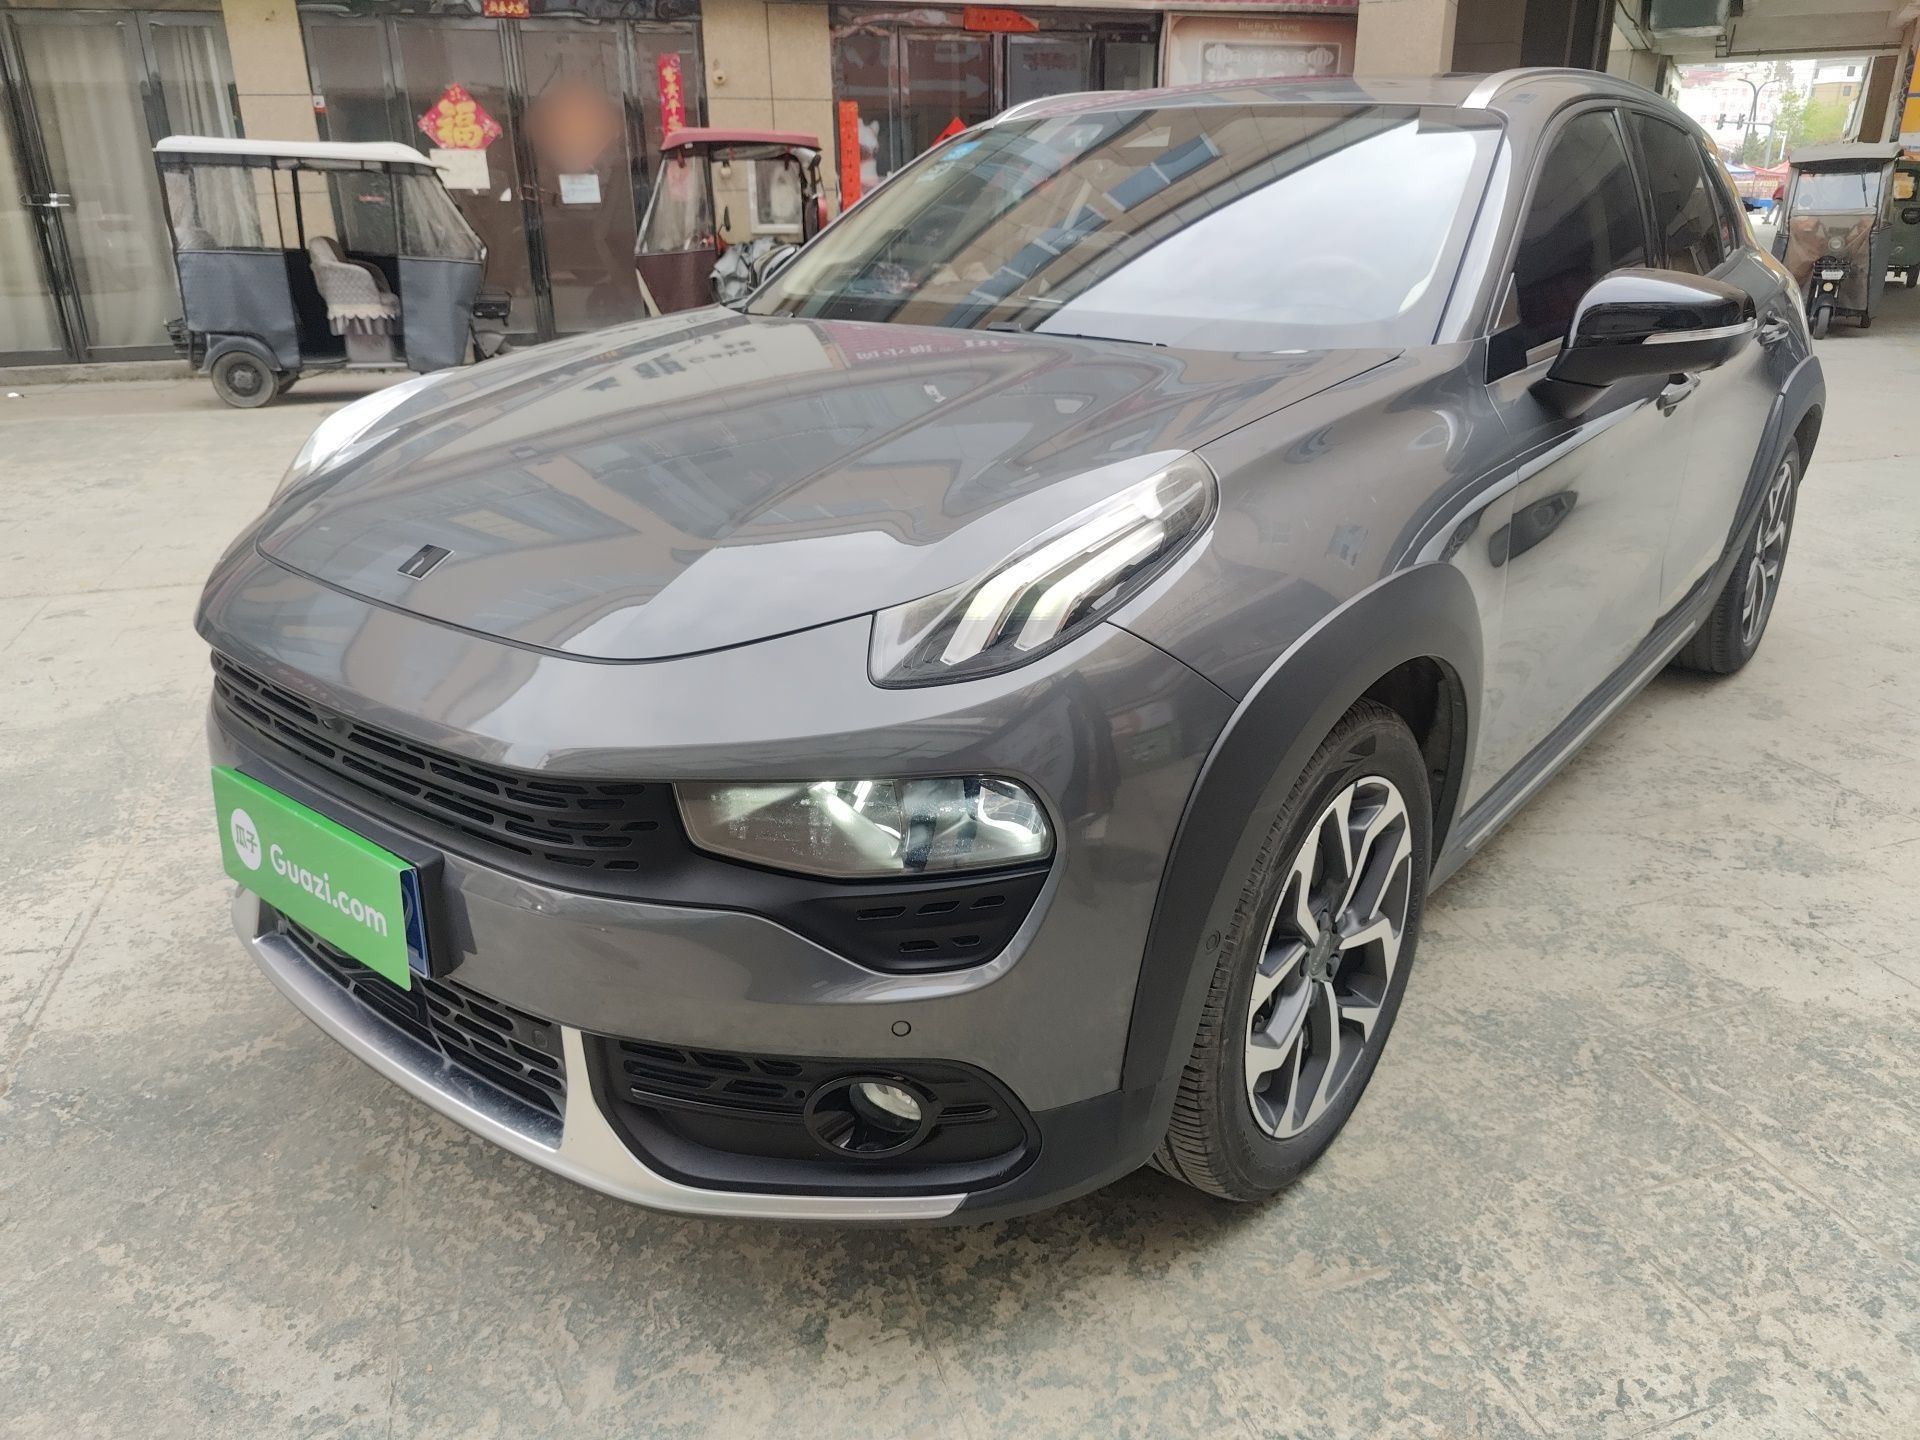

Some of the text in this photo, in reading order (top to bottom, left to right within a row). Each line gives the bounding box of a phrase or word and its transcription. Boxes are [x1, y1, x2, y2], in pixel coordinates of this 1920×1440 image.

[436, 99, 484, 149] 福
[235, 823, 258, 855] 瓜子
[270, 843, 388, 938] Guazi.com
